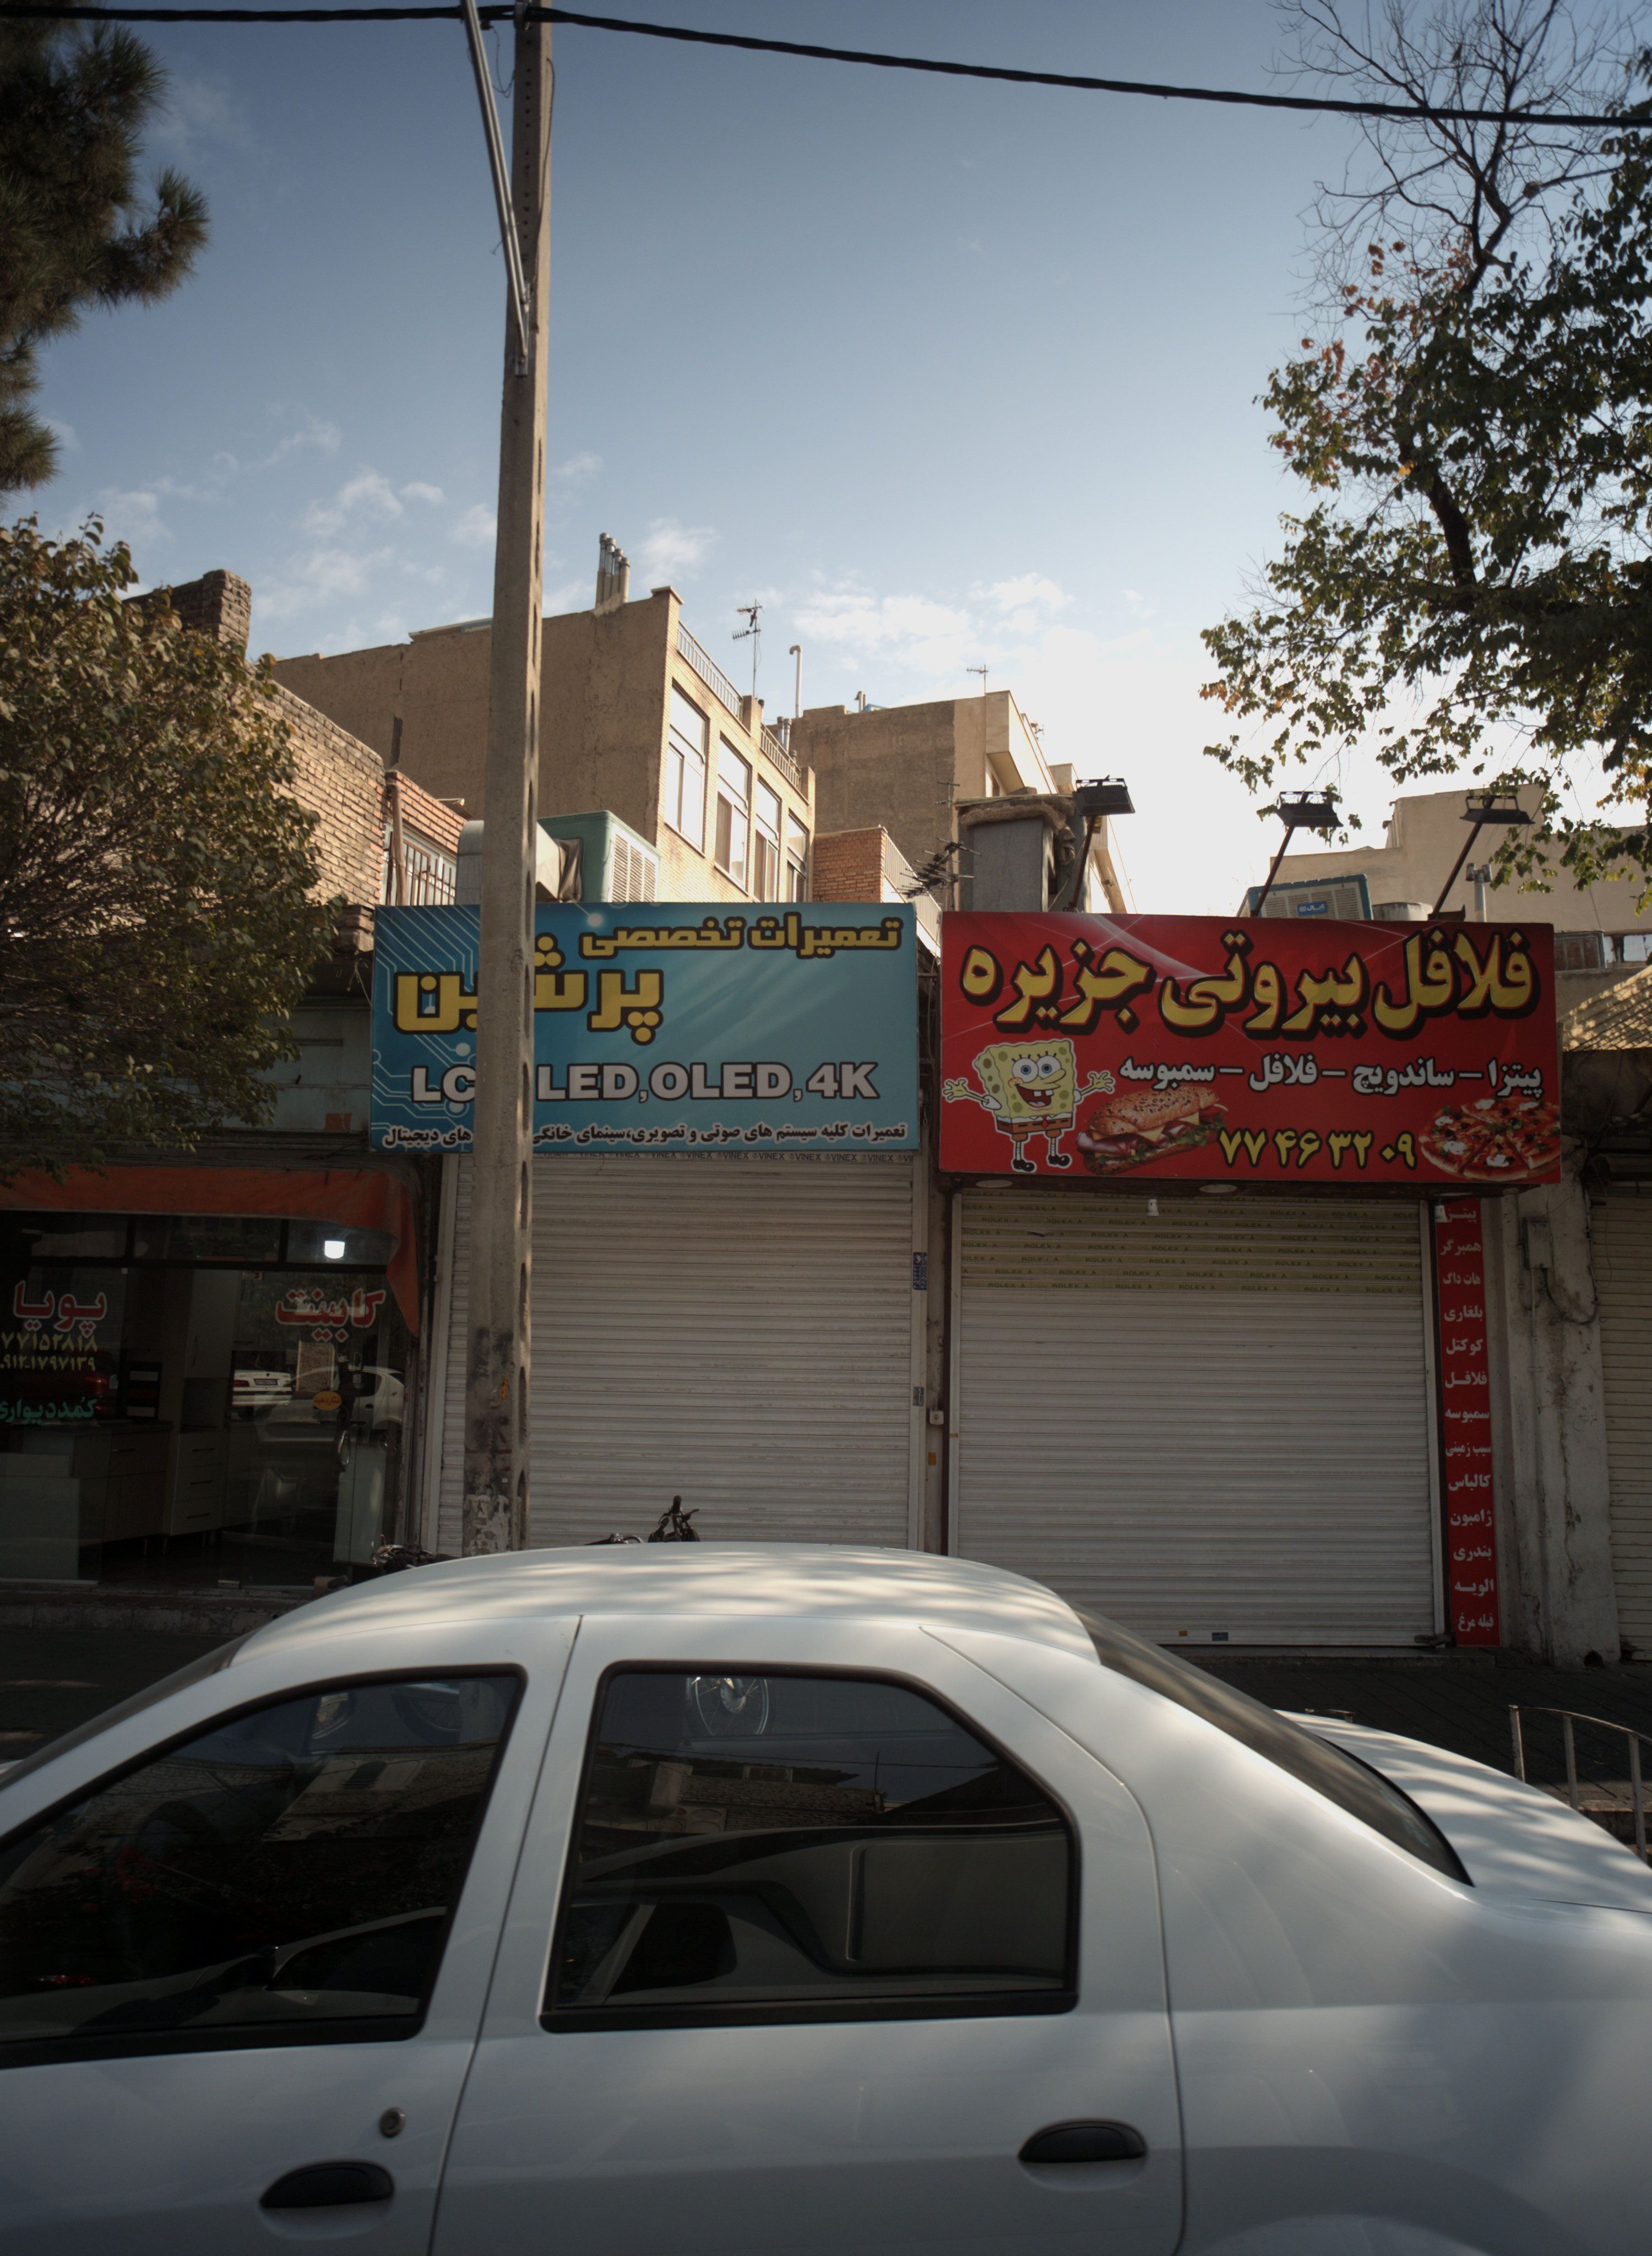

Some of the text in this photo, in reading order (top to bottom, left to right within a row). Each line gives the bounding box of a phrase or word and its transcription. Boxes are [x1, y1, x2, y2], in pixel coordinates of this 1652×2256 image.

[579, 912, 903, 959] تعمیرات تخصصی
[394, 932, 664, 1046] پرشن
[960, 928, 1537, 1038] فلافل بیروتی جزیره
[1118, 1052, 1544, 1099] پیتزا ساندویچ فلافل سمبوسه
[385, 1127, 439, 1146] دیجیتال
[533, 1126, 572, 1144] خانگی
[688, 1129, 697, 1142] و
[702, 1125, 740, 1143] صوتی
[745, 1124, 772, 1141] های
[776, 1125, 817, 1141] سیستم
[822, 1124, 849, 1140] کلیه
[852, 1124, 906, 1141] تعمیرات
[1447, 1208, 1477, 1223] پیتز
[1443, 1272, 1481, 1285] هات داگ
[13, 1279, 107, 1338] پویا
[276, 1287, 386, 1343] کابینت
[1444, 1304, 1483, 1322] بلغاری
[1445, 1370, 1487, 1389] فلافل
[1445, 1408, 1490, 1423] سمبوسه
[1446, 1441, 1492, 1457] سیب زمینی
[1448, 1473, 1491, 1491] کالباس
[1450, 1509, 1492, 1526] ژامبون
[1453, 1545, 1492, 1561] بندری
[1454, 1578, 1494, 1596] الویه
[1458, 1612, 1494, 1631] فیله مرغ
